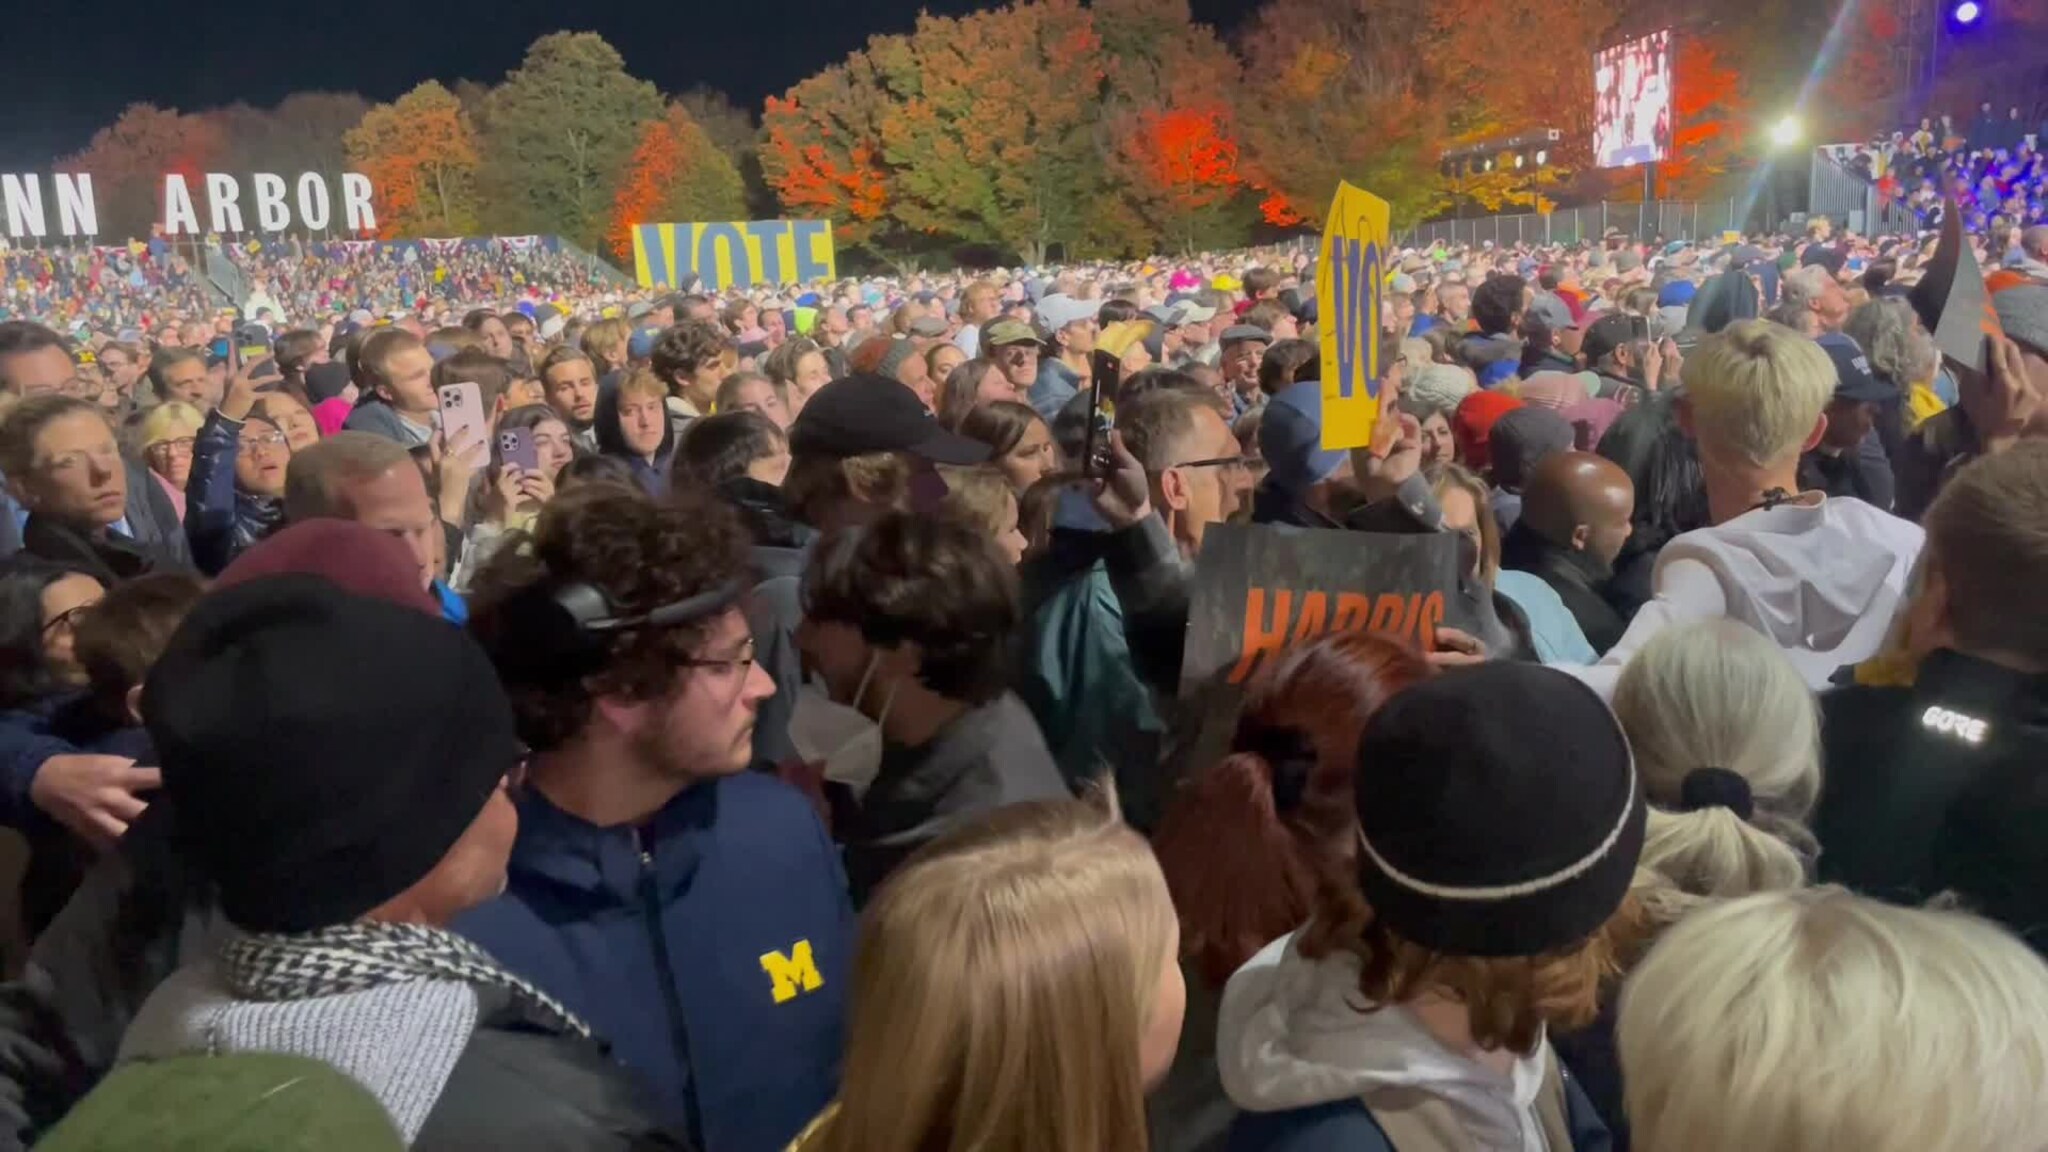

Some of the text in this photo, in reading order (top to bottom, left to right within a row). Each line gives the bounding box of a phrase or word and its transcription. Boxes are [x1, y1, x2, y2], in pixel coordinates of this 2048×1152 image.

[165, 171, 376, 234] ARBOR
[639, 220, 829, 289] VOTE
[759, 938, 825, 1004] M
